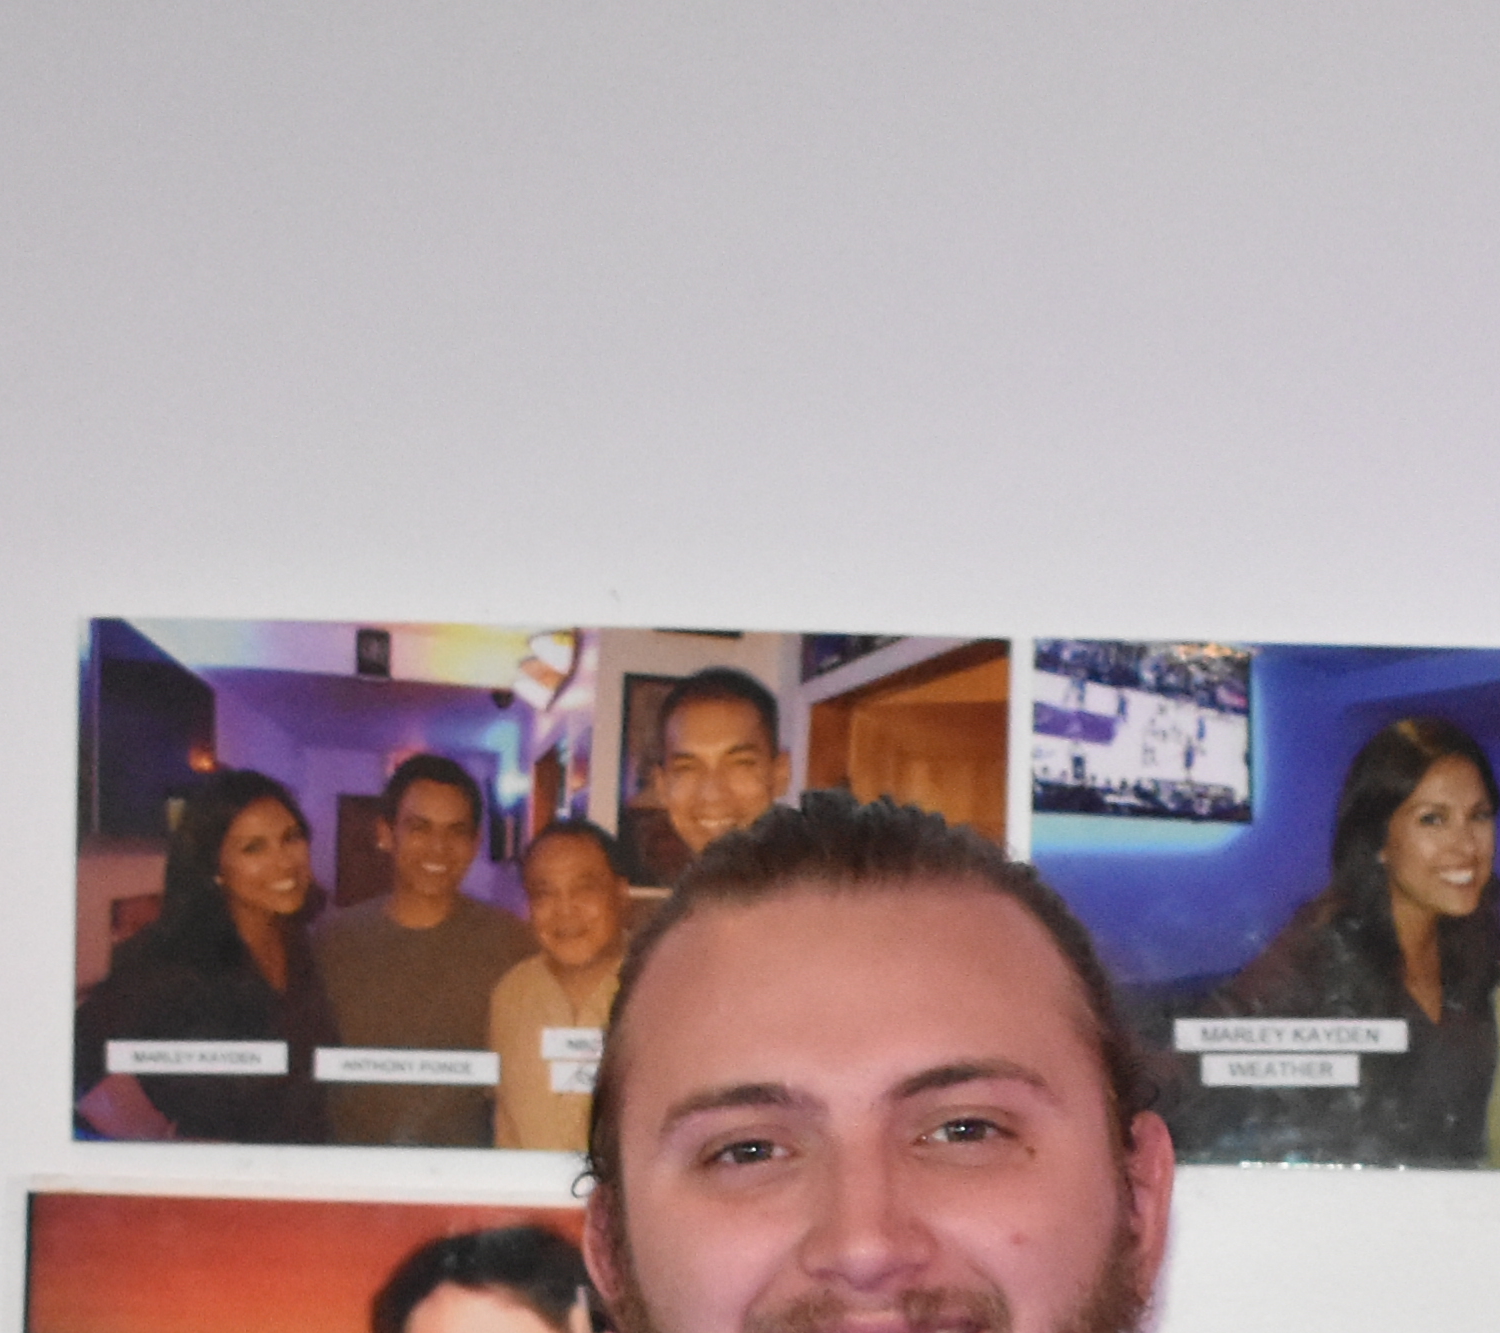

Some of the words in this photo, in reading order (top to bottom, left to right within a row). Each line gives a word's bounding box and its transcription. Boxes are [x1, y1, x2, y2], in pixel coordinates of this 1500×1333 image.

[1200, 1026, 1291, 1044] MARLEY
[1294, 1027, 1380, 1045] KAYDEN
[1228, 1060, 1333, 1078] WEATHER
